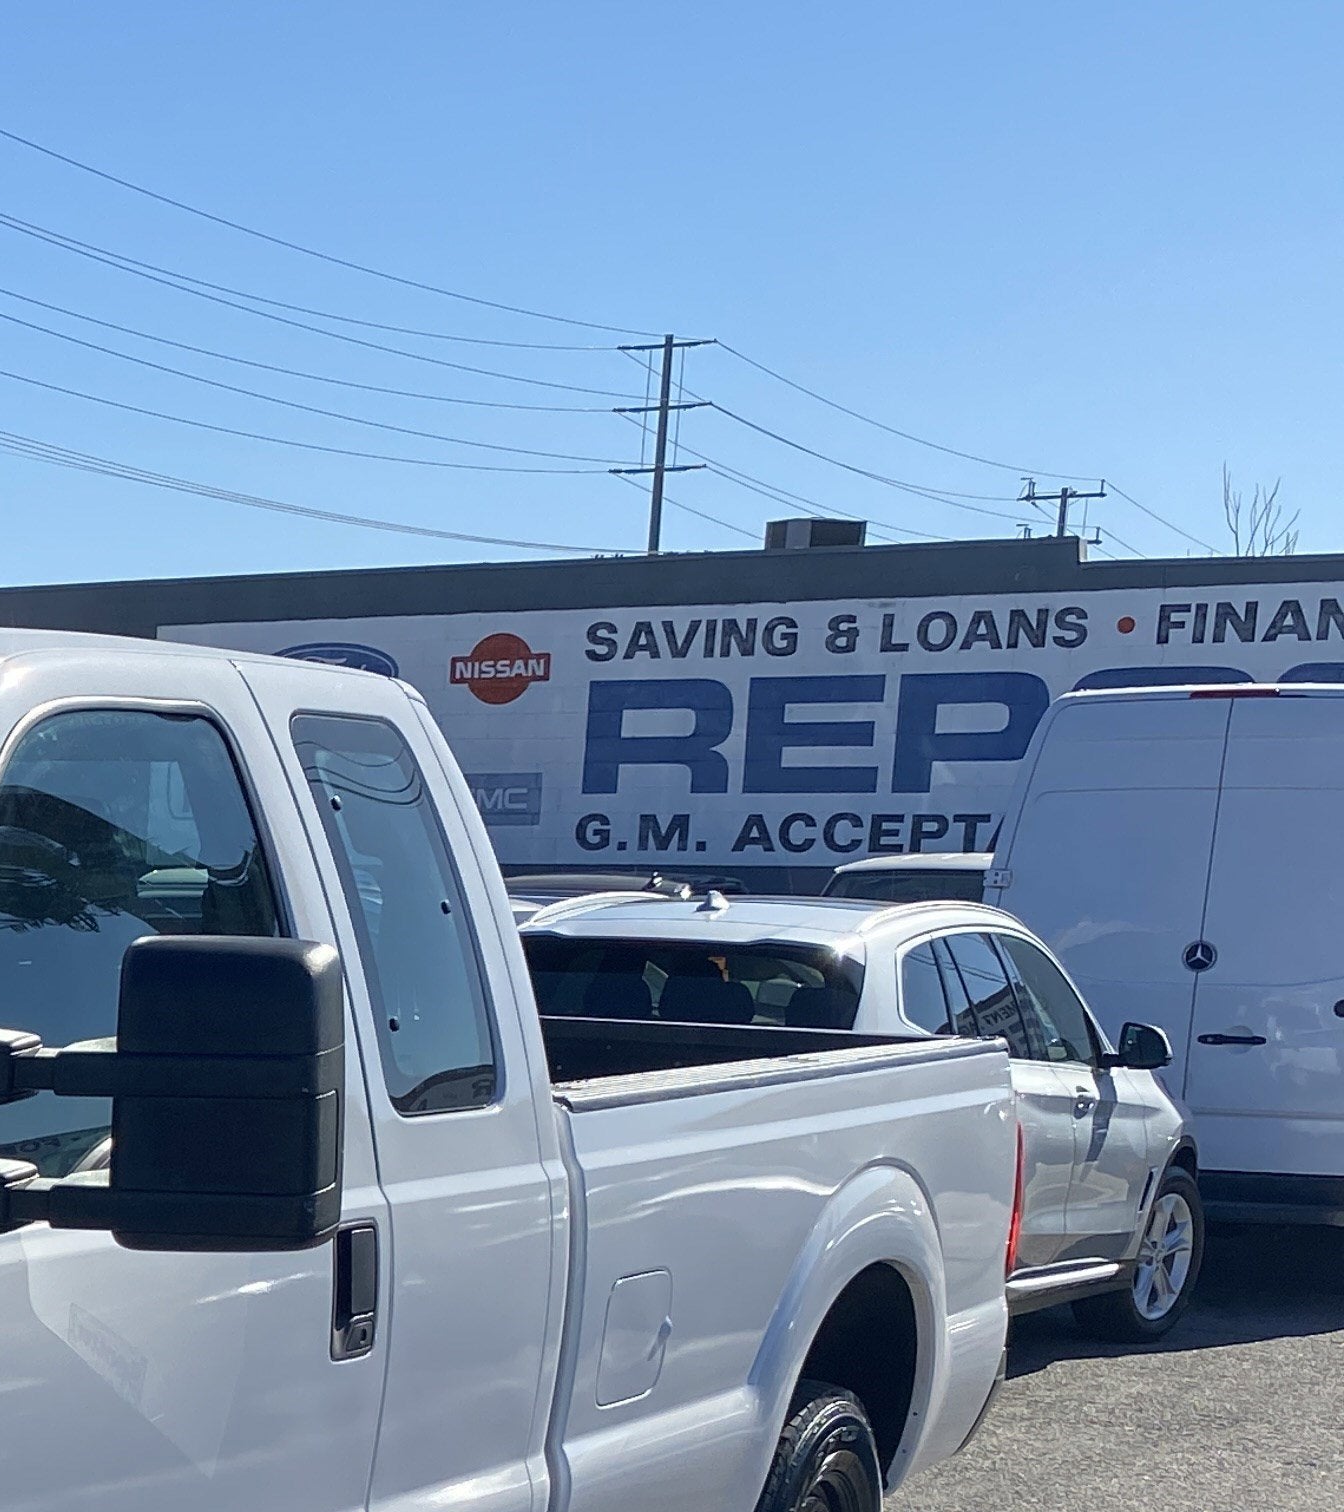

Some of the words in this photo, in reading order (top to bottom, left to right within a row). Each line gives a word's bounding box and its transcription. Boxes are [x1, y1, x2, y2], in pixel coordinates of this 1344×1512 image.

[585, 616, 799, 662] SAVING
[824, 614, 860, 655] &
[879, 606, 1090, 653] LOANS
[454, 658, 546, 679] NISSAN
[581, 661, 1344, 794] REP
[470, 787, 529, 810] MC
[574, 812, 708, 852] G.M.
